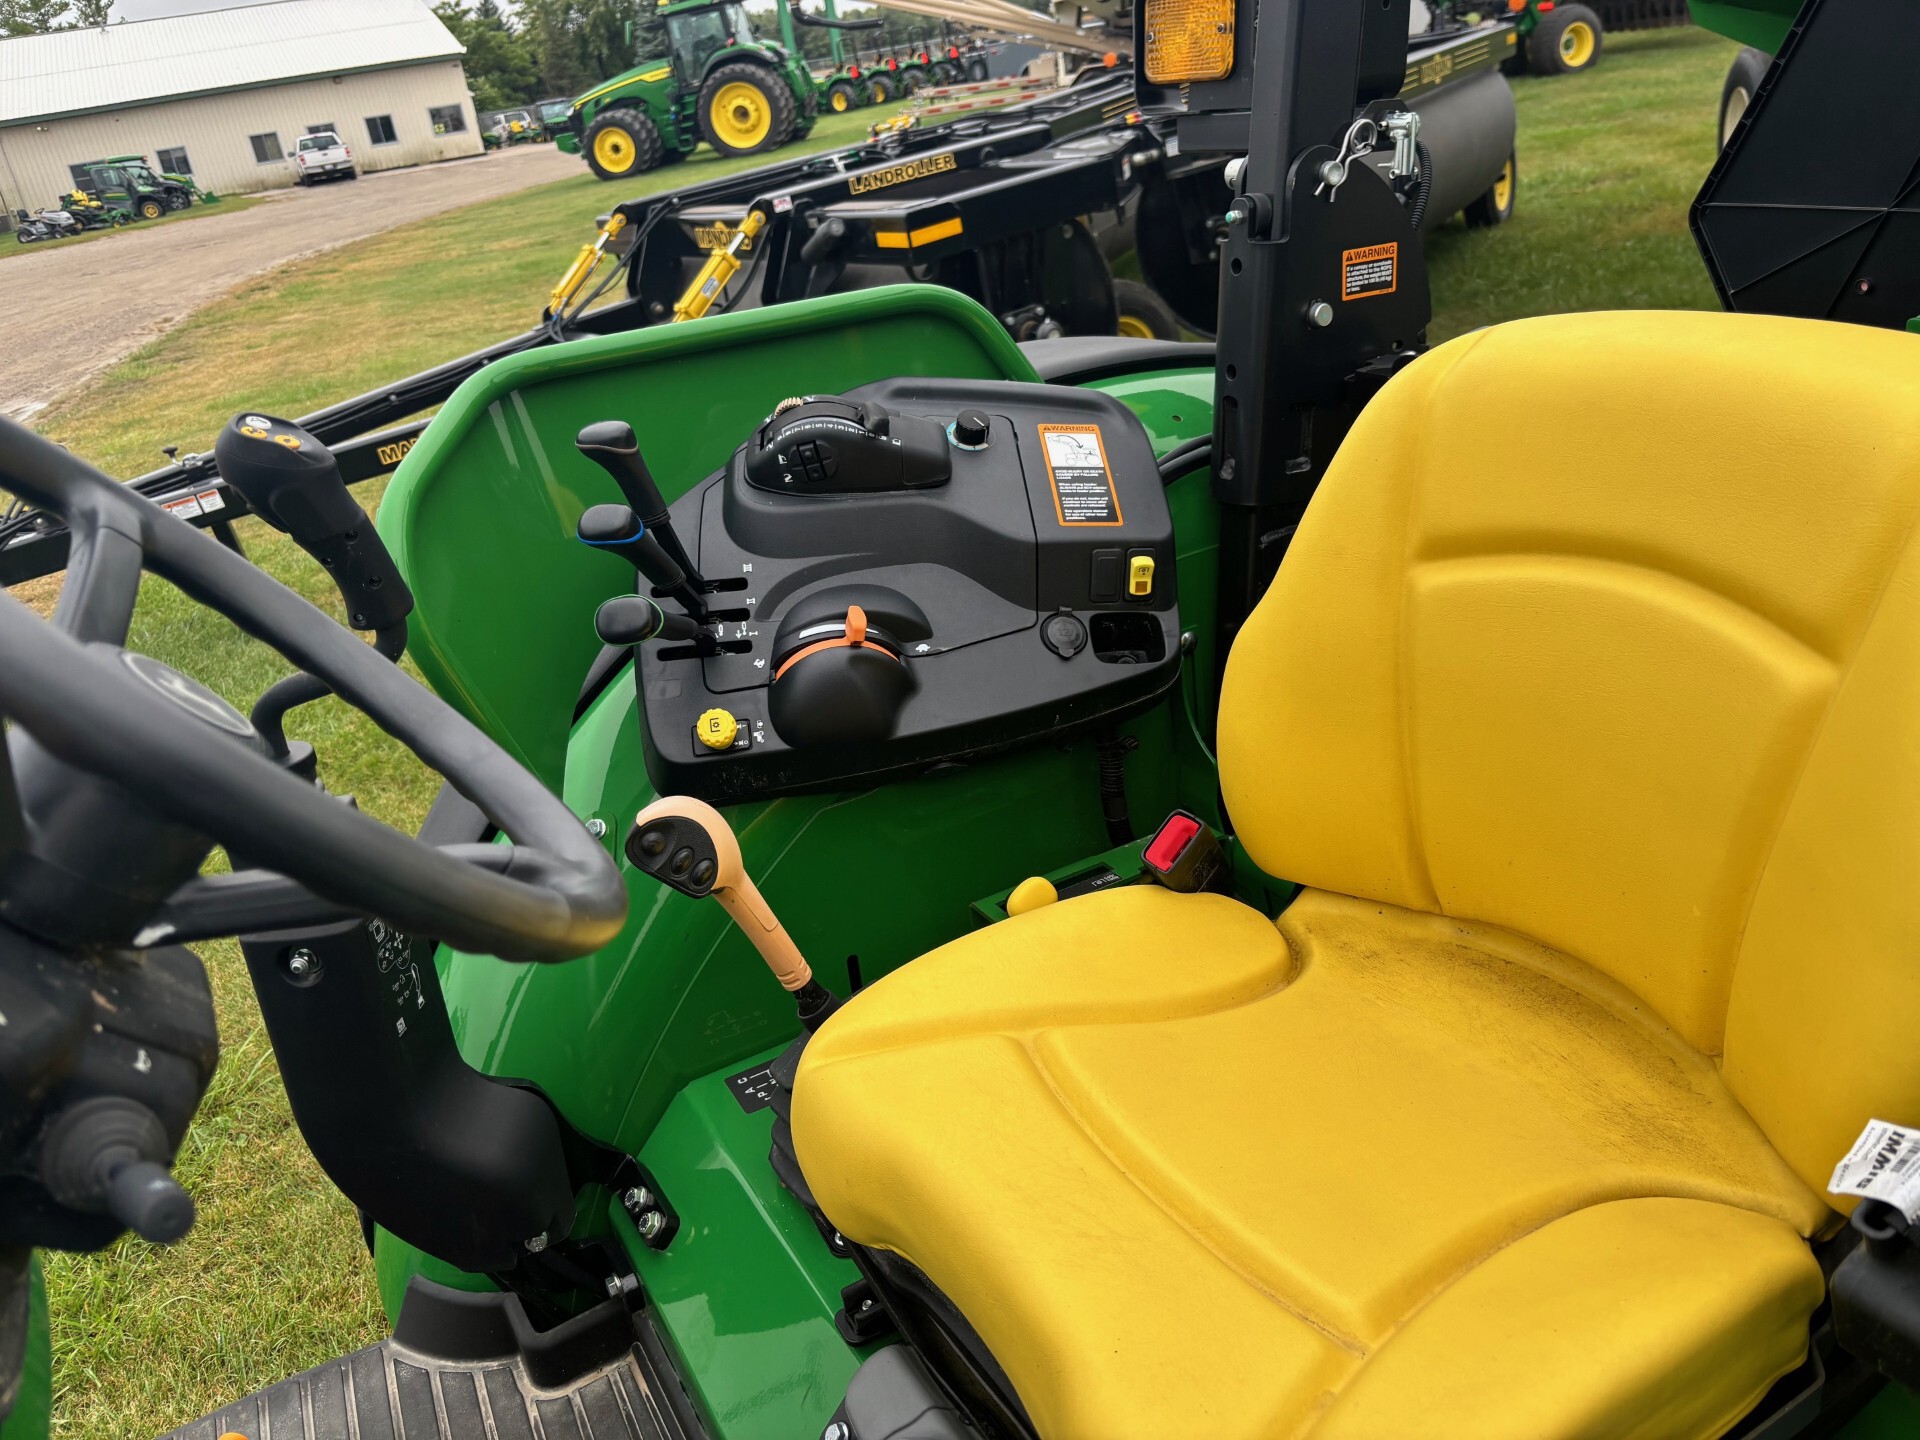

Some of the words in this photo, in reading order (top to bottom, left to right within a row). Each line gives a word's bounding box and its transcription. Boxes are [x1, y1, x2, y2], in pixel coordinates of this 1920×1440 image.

[848, 152, 957, 195] LANDROLLER
[1354, 245, 1395, 260] WARNING
[378, 438, 417, 465] MA
[1868, 1130, 1906, 1178] IMMI
